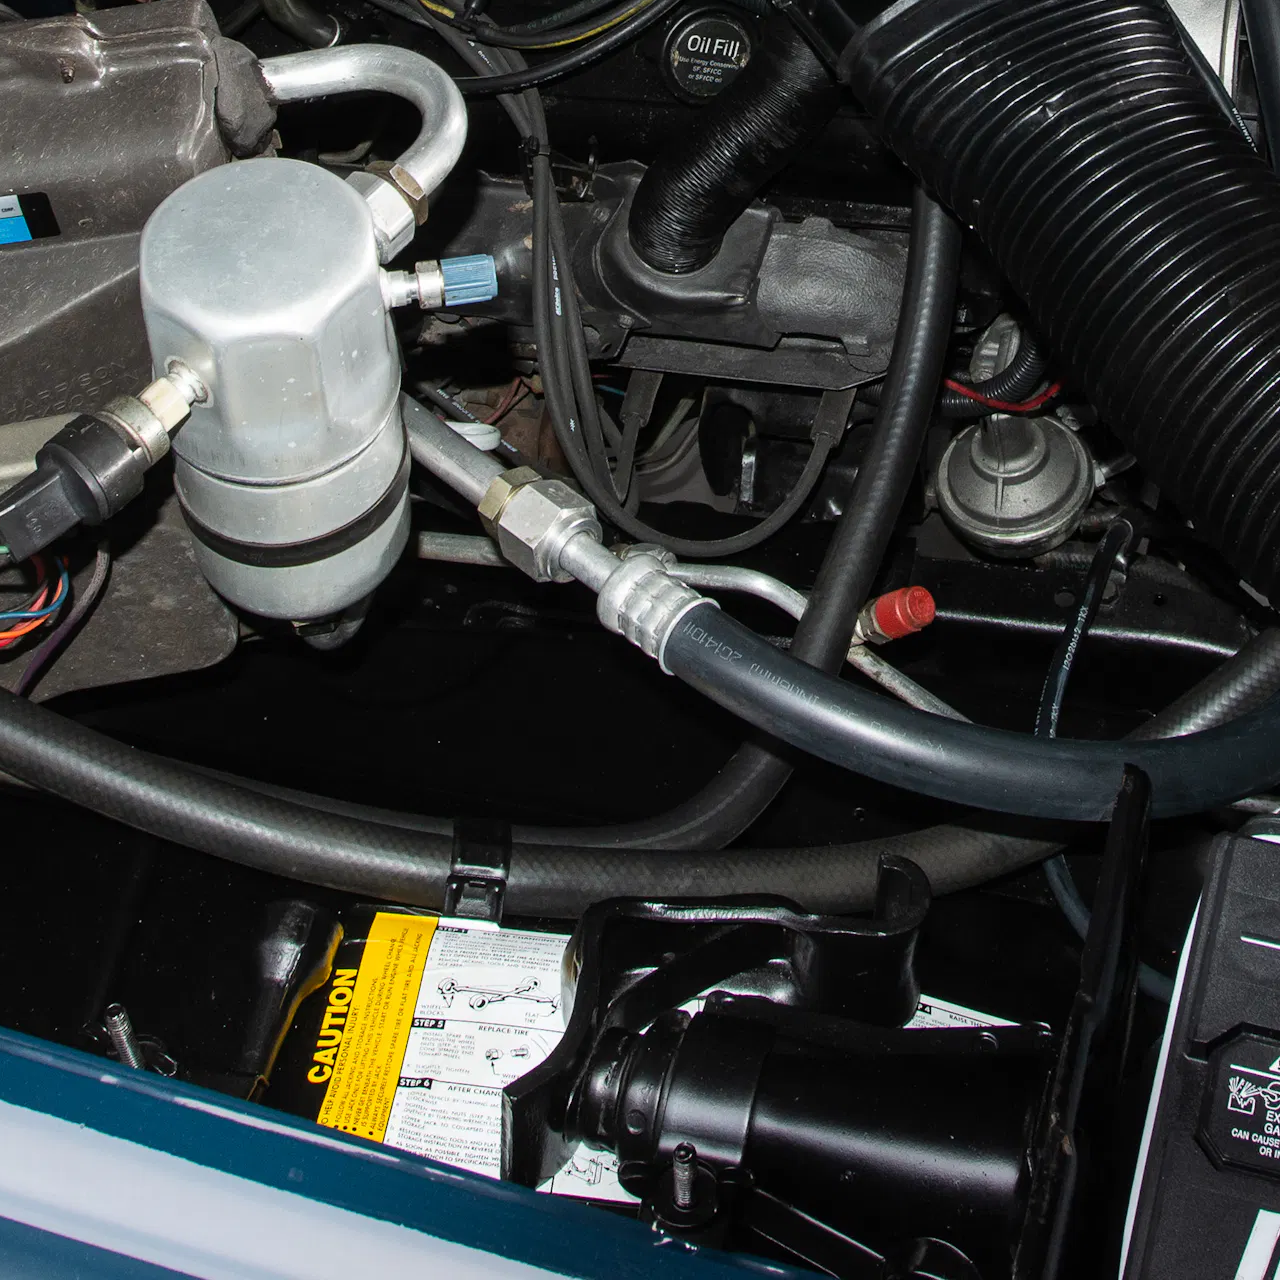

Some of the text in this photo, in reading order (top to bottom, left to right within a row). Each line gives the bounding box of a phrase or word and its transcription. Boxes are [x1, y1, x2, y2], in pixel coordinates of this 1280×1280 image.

[688, 35, 739, 58] Oil Fill
[691, 58, 708, 66] Energy
[414, 1019, 435, 1027] STEP
[949, 1014, 968, 1024] RAISE
[307, 968, 359, 1084] CAUTION
[479, 1025, 511, 1034] REPLACE
[329, 1075, 340, 1098] AVOID
[338, 1035, 352, 1075] PERSONAL
[400, 1078, 422, 1086] STEP
[448, 1084, 471, 1094] AFTER
[1231, 1128, 1249, 1141] CAN
[1251, 1132, 1280, 1147] CAUSE
[1259, 1147, 1273, 1157] OR
